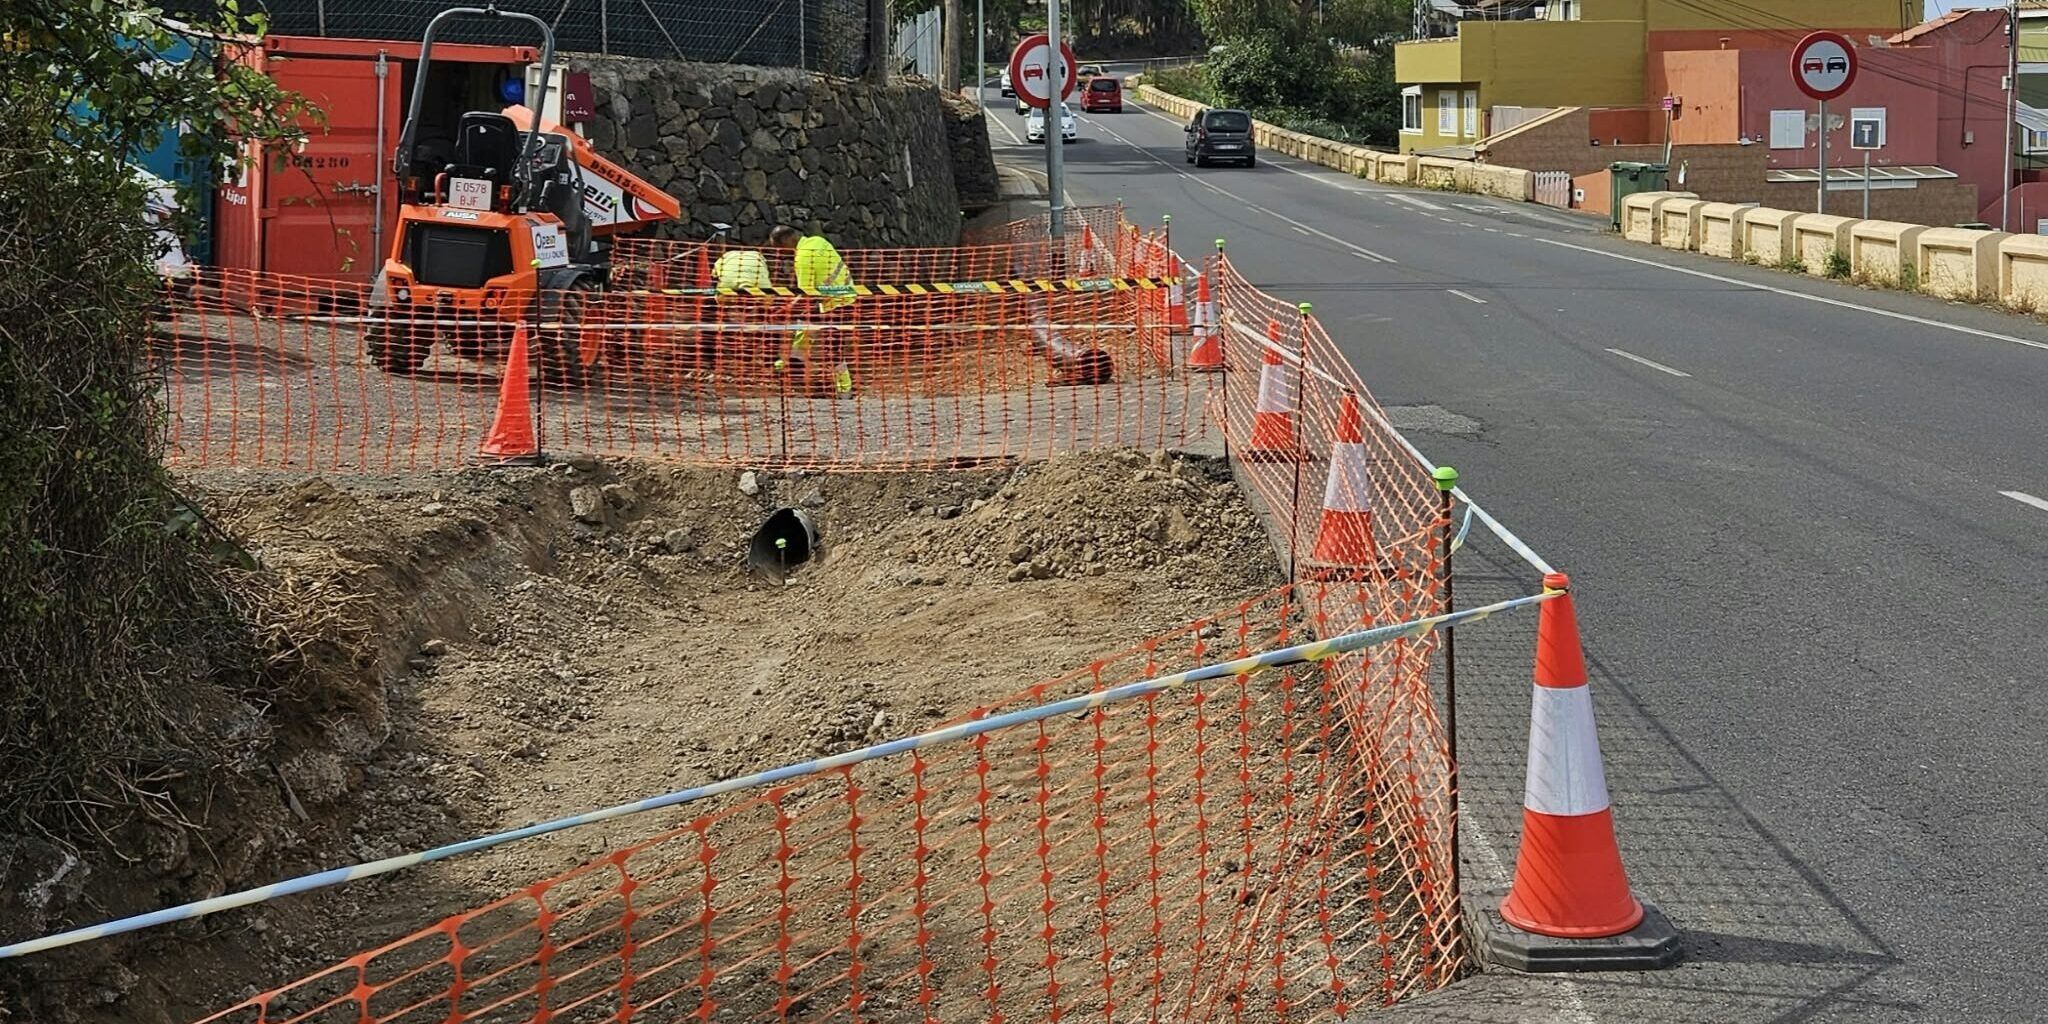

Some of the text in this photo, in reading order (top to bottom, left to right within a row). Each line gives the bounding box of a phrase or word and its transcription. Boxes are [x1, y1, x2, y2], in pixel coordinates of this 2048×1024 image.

[455, 182, 487, 194] E 0578
[460, 195, 479, 206] BJF
